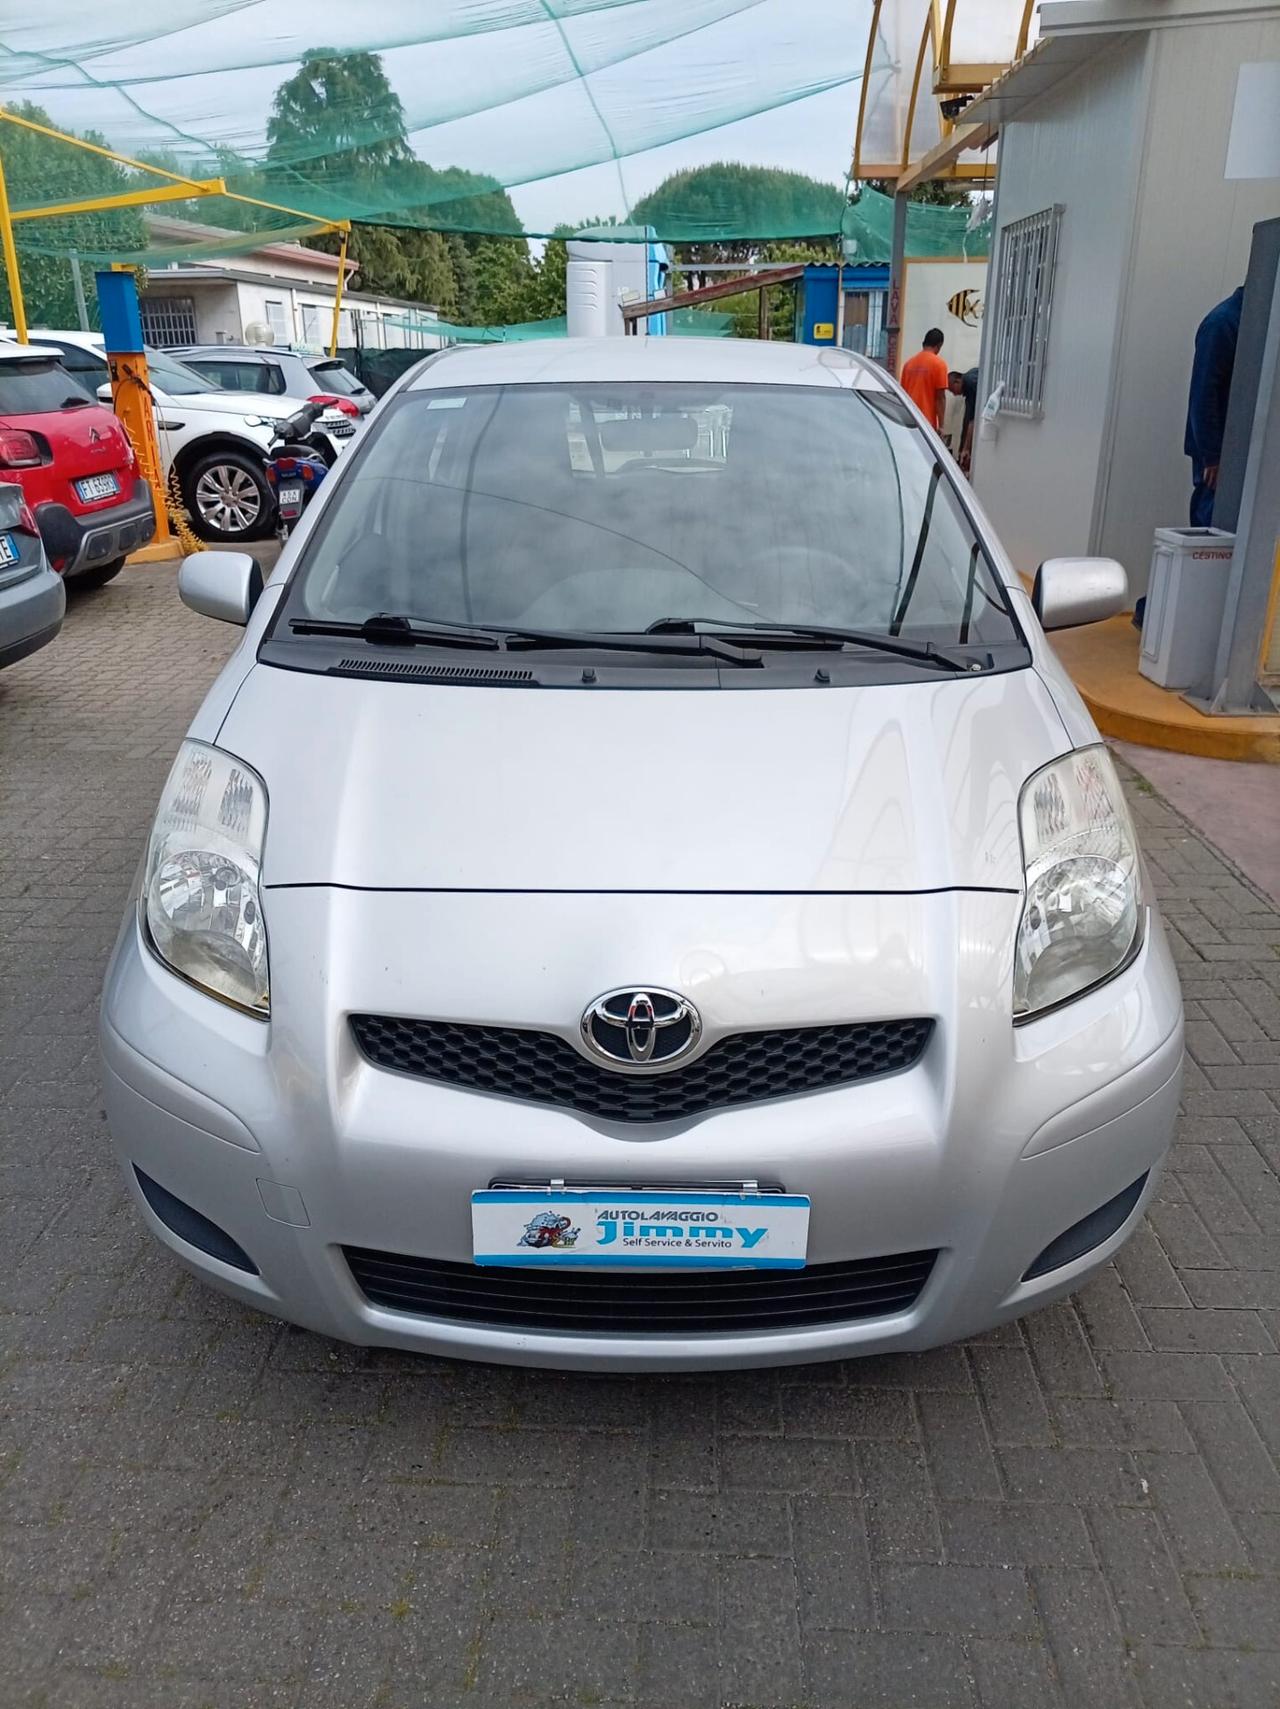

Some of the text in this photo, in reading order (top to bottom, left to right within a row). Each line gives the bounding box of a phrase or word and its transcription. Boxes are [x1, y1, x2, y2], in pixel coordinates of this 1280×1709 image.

[144, 396, 161, 489] ARIA
[1192, 551, 1233, 560] CESTINO
[597, 1210, 719, 1222] AUTOLAVAGGIO
[623, 1237, 732, 1248] Self Service & Servito
